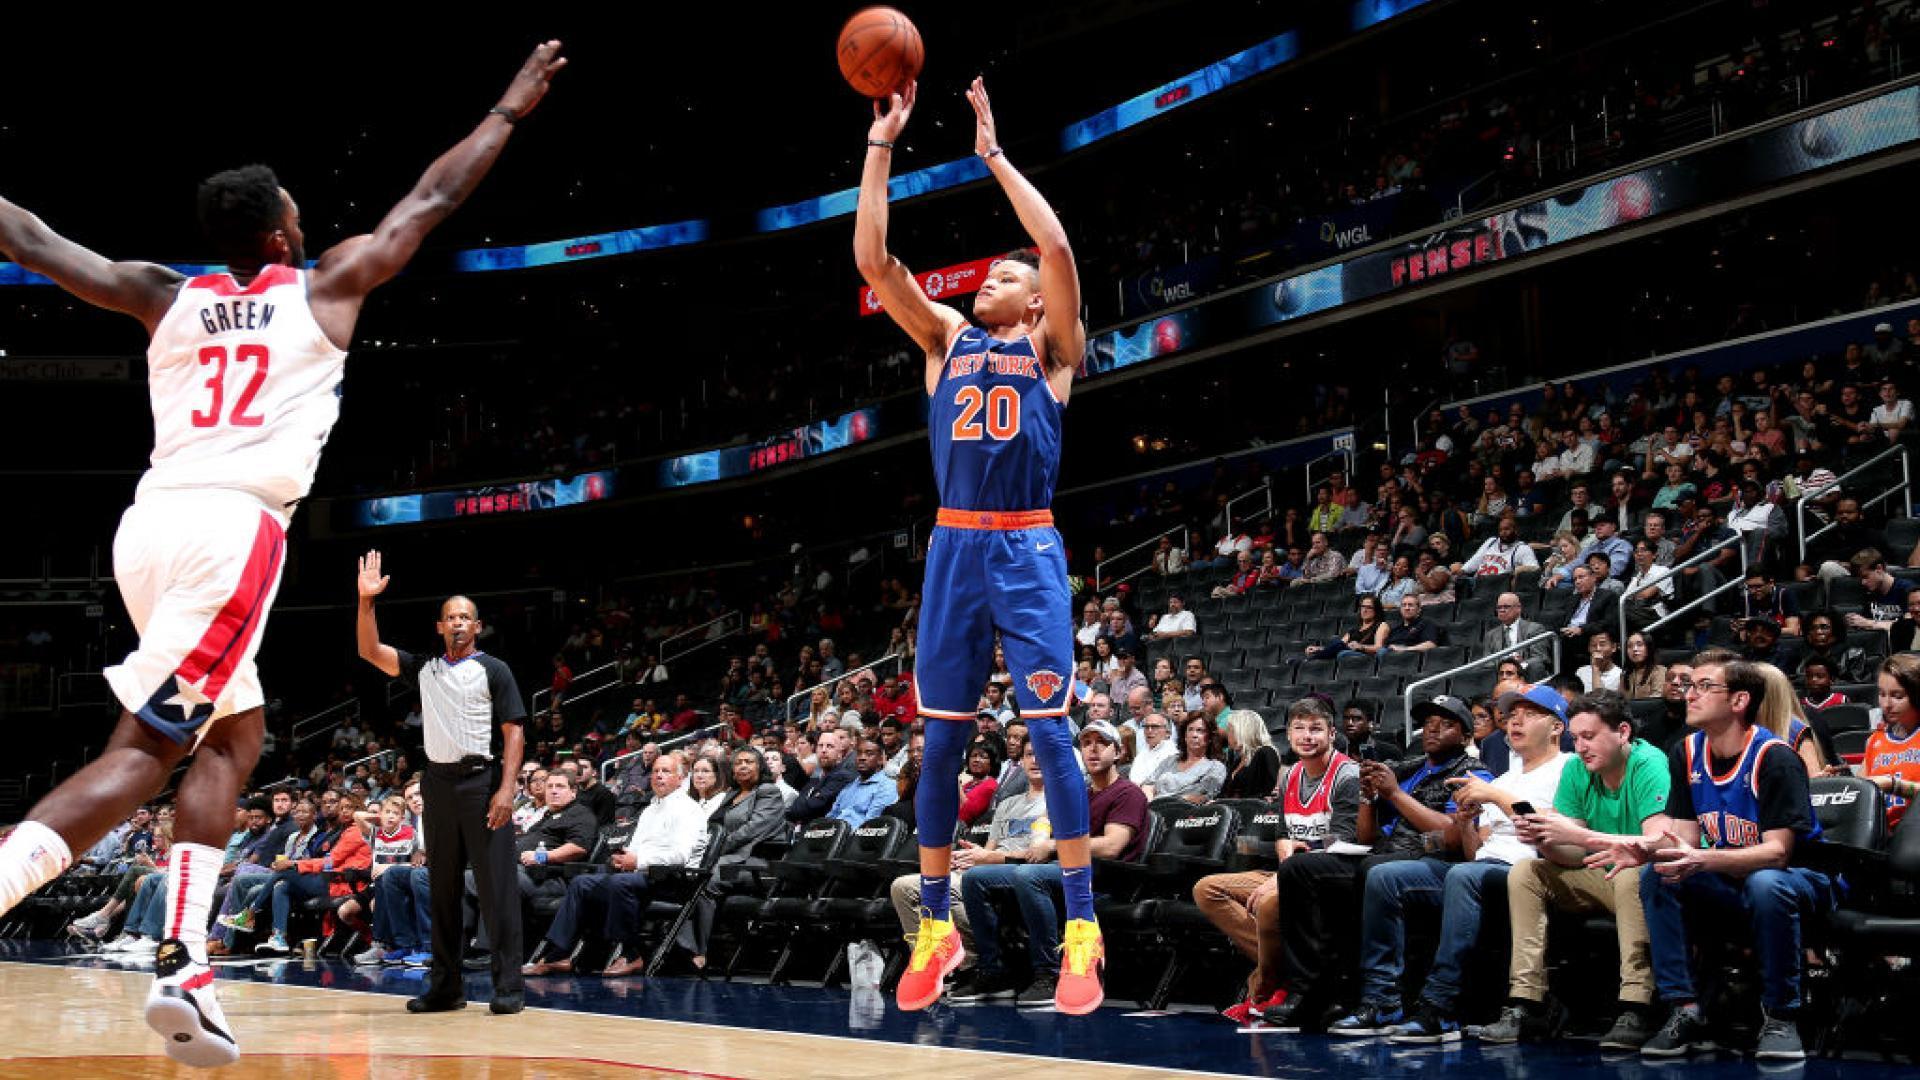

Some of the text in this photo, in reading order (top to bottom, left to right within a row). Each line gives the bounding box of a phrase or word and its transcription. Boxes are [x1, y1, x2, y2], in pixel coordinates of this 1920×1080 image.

[1335, 223, 1372, 249] WGL
[200, 300, 275, 335] GREEN
[987, 352, 1037, 380] YORK
[190, 344, 269, 428] 32
[952, 385, 1021, 441] 20
[1810, 784, 1861, 807] ards
[1174, 812, 1222, 829] wizards
